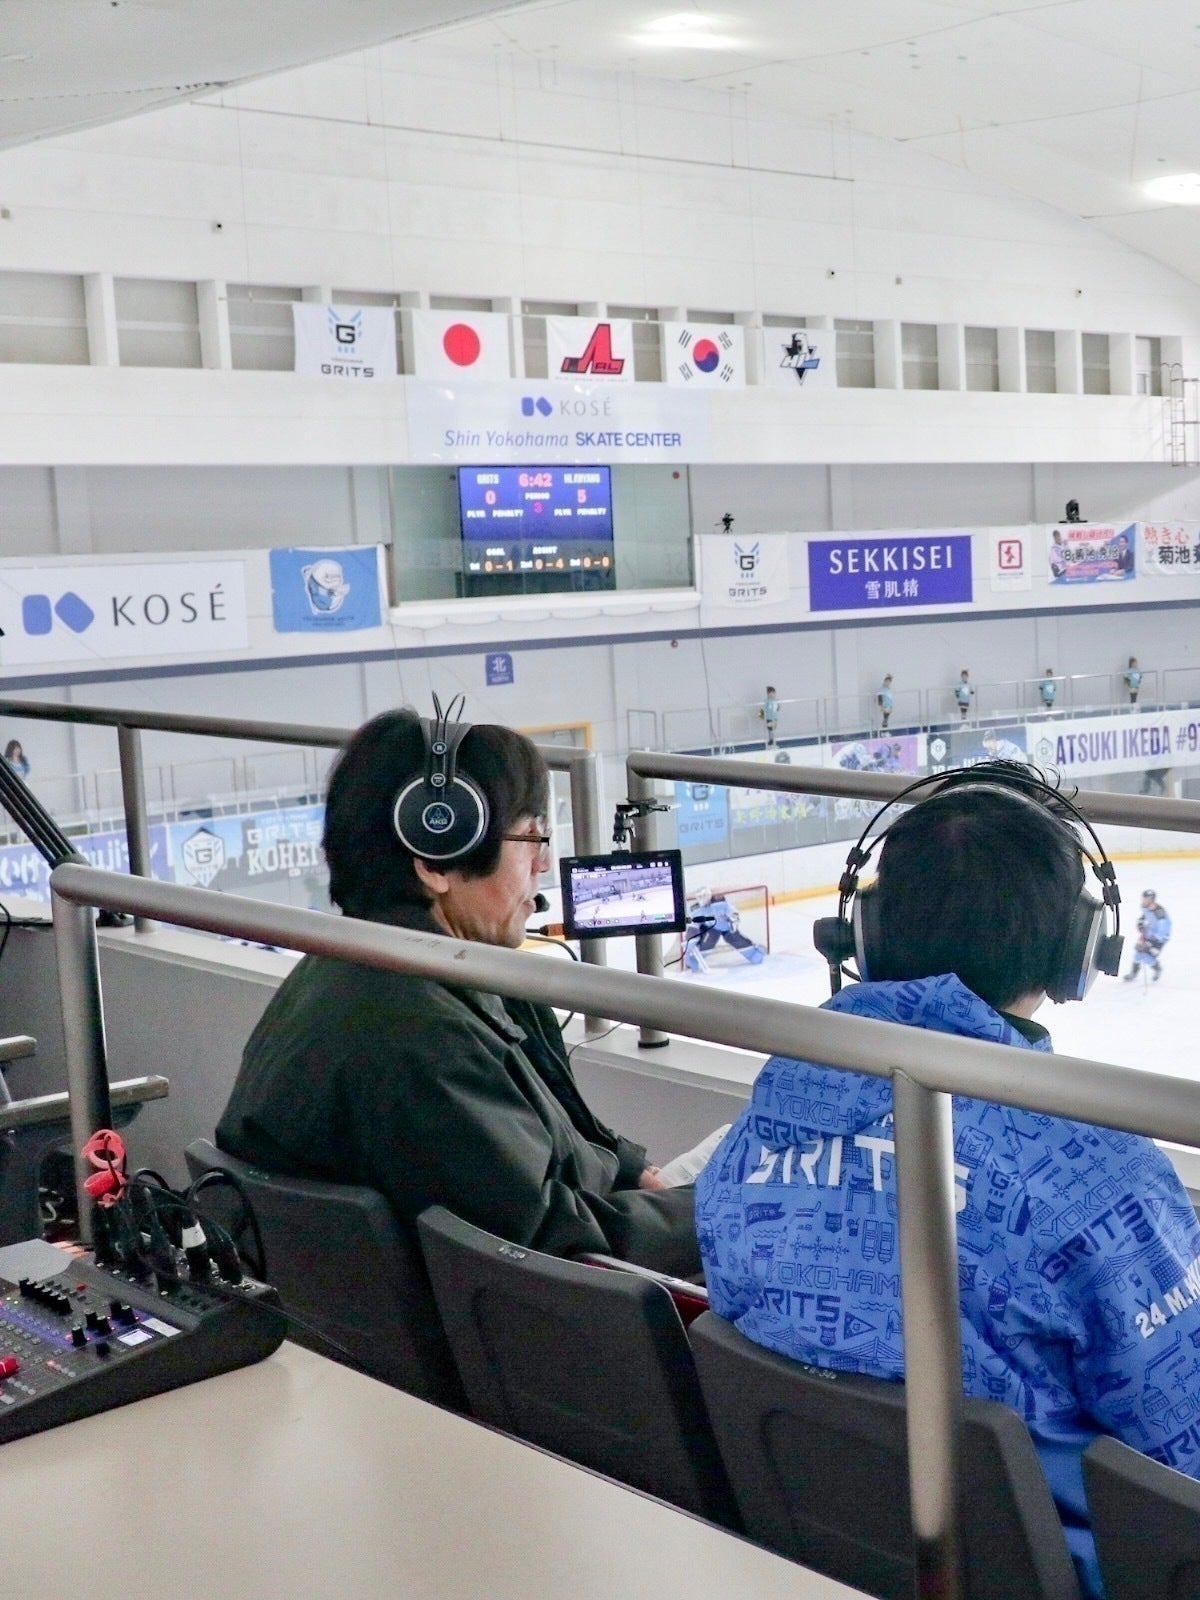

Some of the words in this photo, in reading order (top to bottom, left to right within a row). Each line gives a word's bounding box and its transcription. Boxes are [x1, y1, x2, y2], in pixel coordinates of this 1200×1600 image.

[321, 364, 374, 378] GRITS
[560, 396, 613, 417] KOSÉ
[444, 430, 480, 447] Shin
[487, 430, 569, 447] Yokohama
[576, 432, 623, 446] SKATE
[625, 432, 681, 447] CENTER
[519, 473, 553, 487] 6:42
[485, 490, 496, 505] 0
[577, 489, 587, 503] 5
[829, 545, 953, 575] SEKKISEI
[729, 586, 768, 598] GRITS
[865, 579, 920, 601] 雪肌精
[111, 583, 227, 627] KOSÉ
[1056, 731, 1119, 766] ATSUKI
[1123, 725, 1171, 757] IKEDA
[247, 821, 321, 845] GRITS
[679, 818, 725, 834] GRITS
[247, 841, 319, 876] KOHEI
[775, 1092, 854, 1130] YOKOH
[1038, 1151, 1160, 1243] YOKOHAM
[1039, 1192, 1144, 1284] GRITS
[766, 1261, 900, 1298] YOKOHAM
[1135, 1302, 1167, 1339] 24
